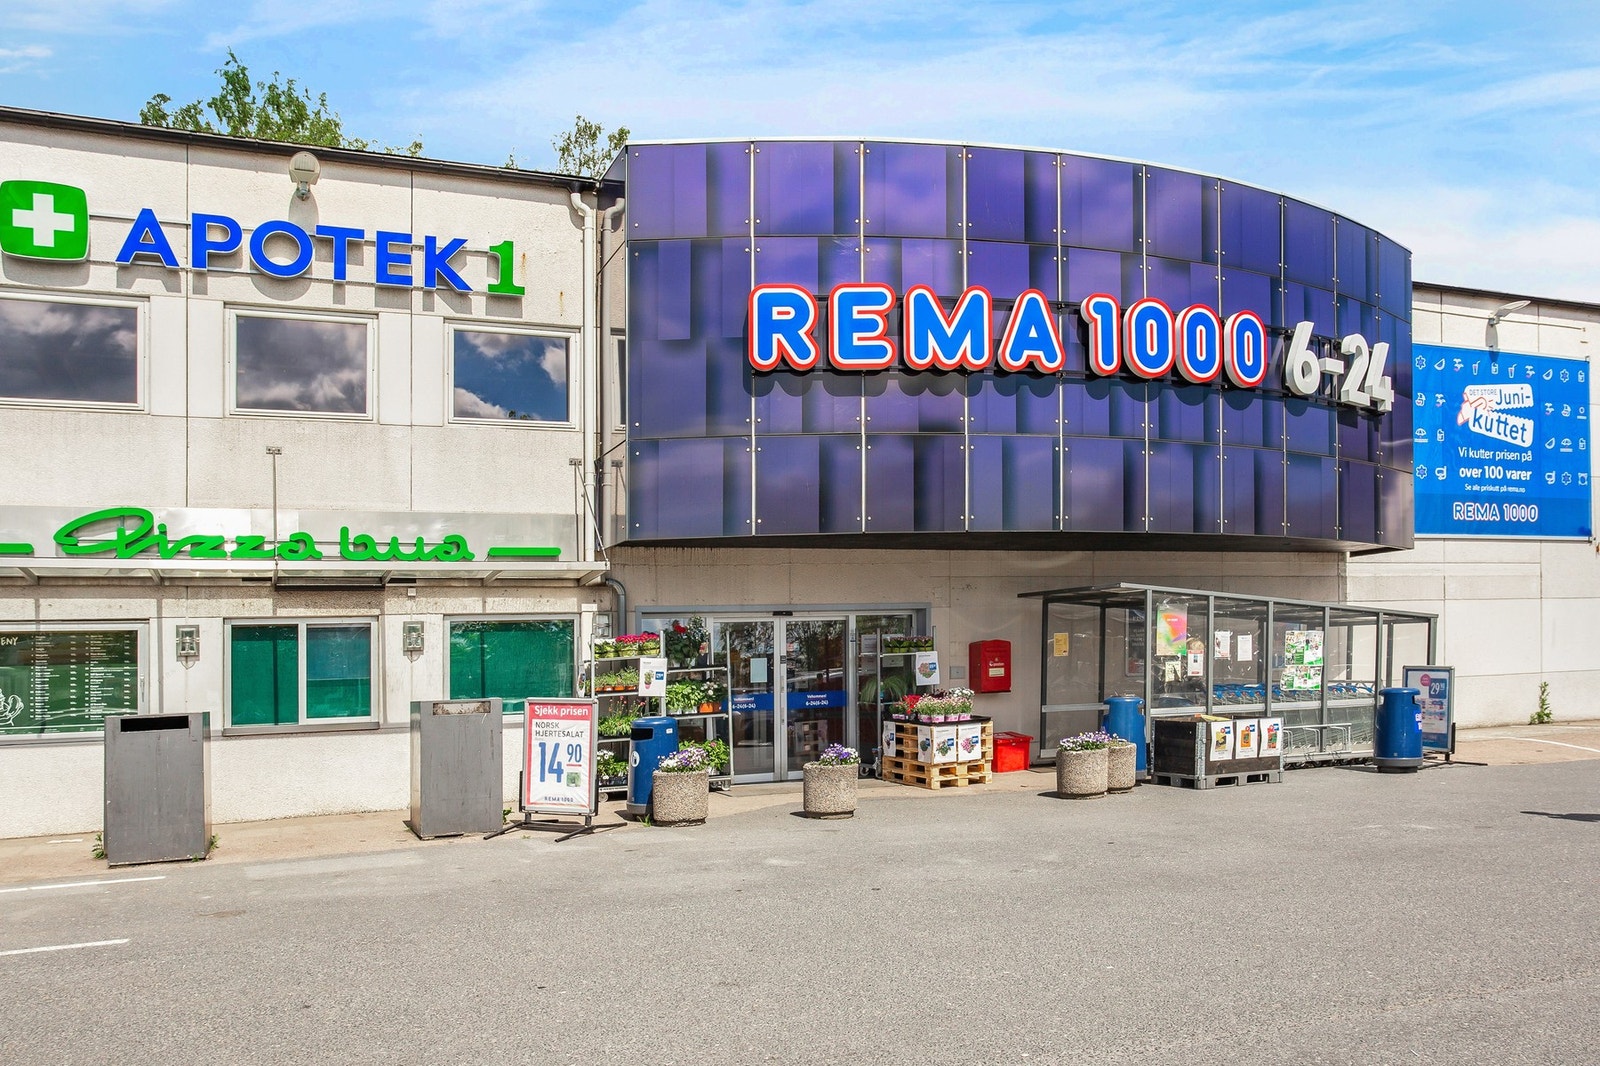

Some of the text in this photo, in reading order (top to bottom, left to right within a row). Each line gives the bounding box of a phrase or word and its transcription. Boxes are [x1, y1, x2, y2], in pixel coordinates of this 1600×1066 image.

[115, 207, 525, 297] APOTEK 1
[749, 284, 1394, 411] REMA 1000 6-24
[1495, 387, 1531, 406] Juni-
[1472, 407, 1527, 443] kuttet
[1458, 446, 1532, 463] Vi kutter prisen på
[1459, 465, 1532, 480] over 100 varer
[1464, 483, 1472, 491] Se
[1453, 501, 1539, 522] REMA 1000
[53, 507, 475, 561] Pizza bua
[1430, 682, 1440, 695] 29
[534, 705, 589, 717] Sjekk prisen
[535, 721, 560, 729] NORSK
[535, 730, 584, 738] HJERTESALAT
[538, 741, 582, 783] 14 90
